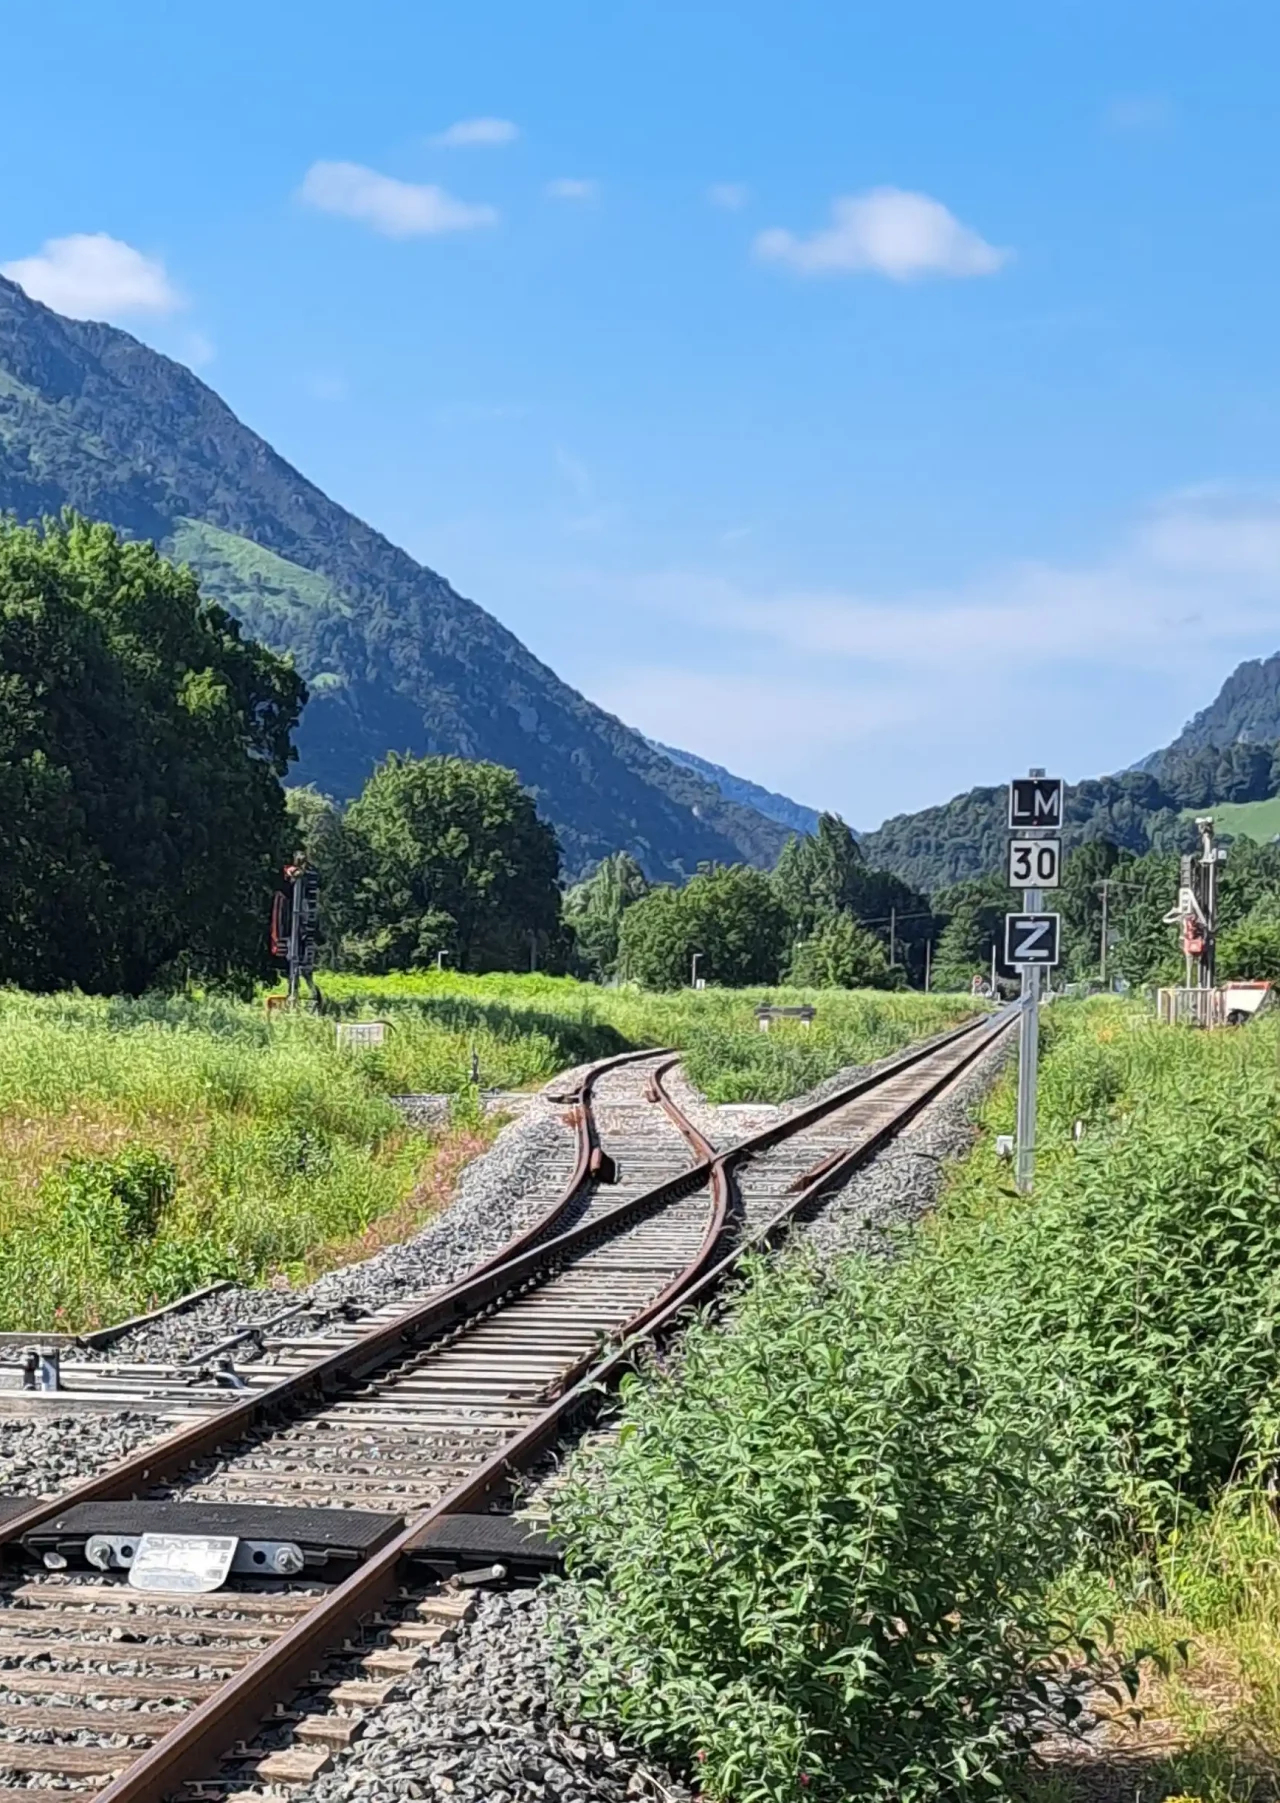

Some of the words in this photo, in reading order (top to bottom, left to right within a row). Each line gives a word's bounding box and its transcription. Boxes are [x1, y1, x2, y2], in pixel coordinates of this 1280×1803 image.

[1013, 788, 1058, 817] LM
[1013, 847, 1055, 880] 30
[1014, 921, 1050, 957] Z
